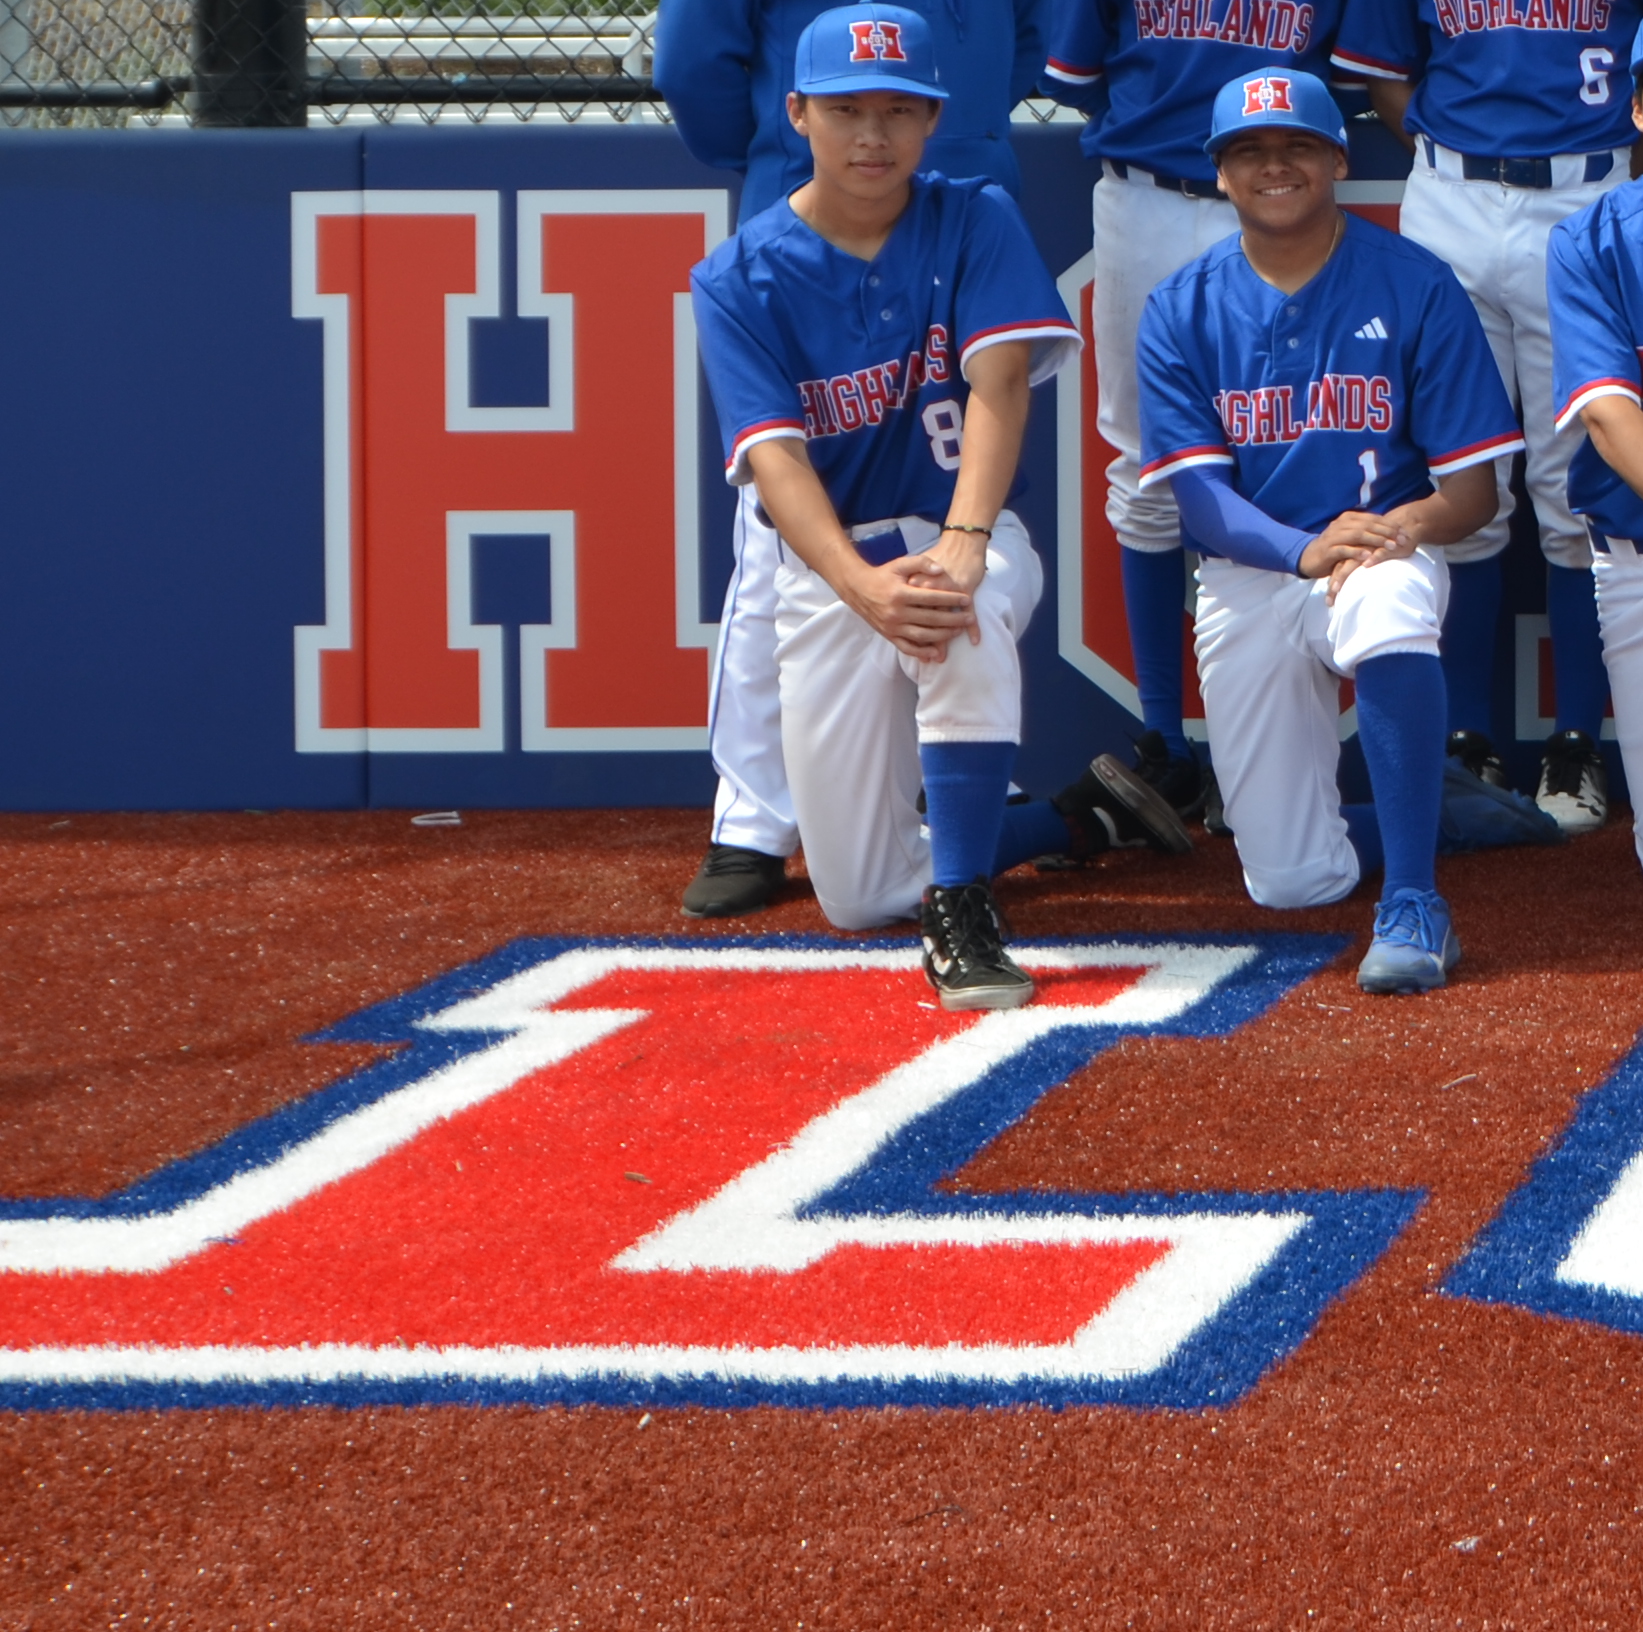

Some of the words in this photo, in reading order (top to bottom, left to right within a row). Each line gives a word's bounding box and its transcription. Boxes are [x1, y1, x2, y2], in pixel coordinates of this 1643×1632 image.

[849, 21, 907, 62] H
[1242, 77, 1292, 116] H
[1576, 47, 1615, 106] 6
[921, 398, 964, 472] 8
[1356, 449, 1379, 509] 1
